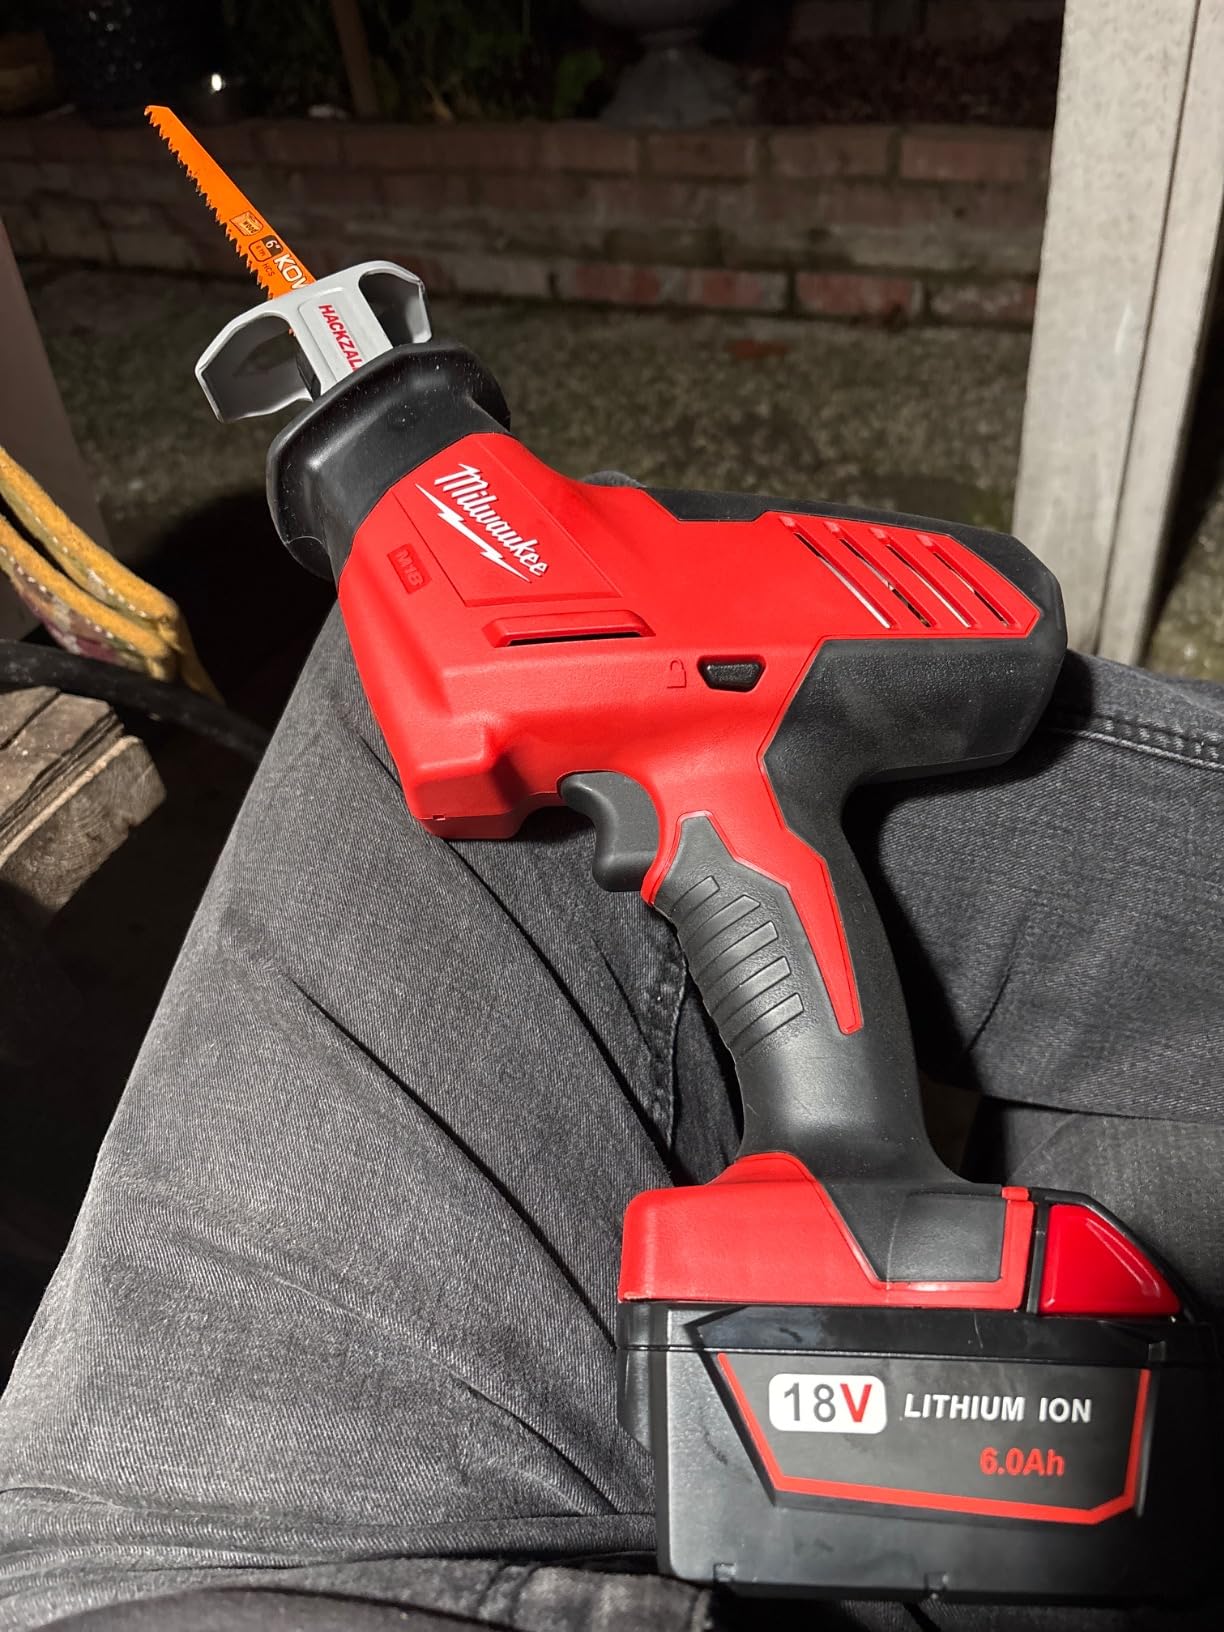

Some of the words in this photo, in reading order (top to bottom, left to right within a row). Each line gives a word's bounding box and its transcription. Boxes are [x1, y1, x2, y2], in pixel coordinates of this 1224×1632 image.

[434, 463, 548, 577] Milwaukee
[395, 549, 424, 586] M18
[783, 1382, 872, 1424] 18V
[903, 1392, 1026, 1423] LITHIUM
[1038, 1397, 1092, 1424] ION
[979, 1446, 1066, 1478] 6.0Ah
